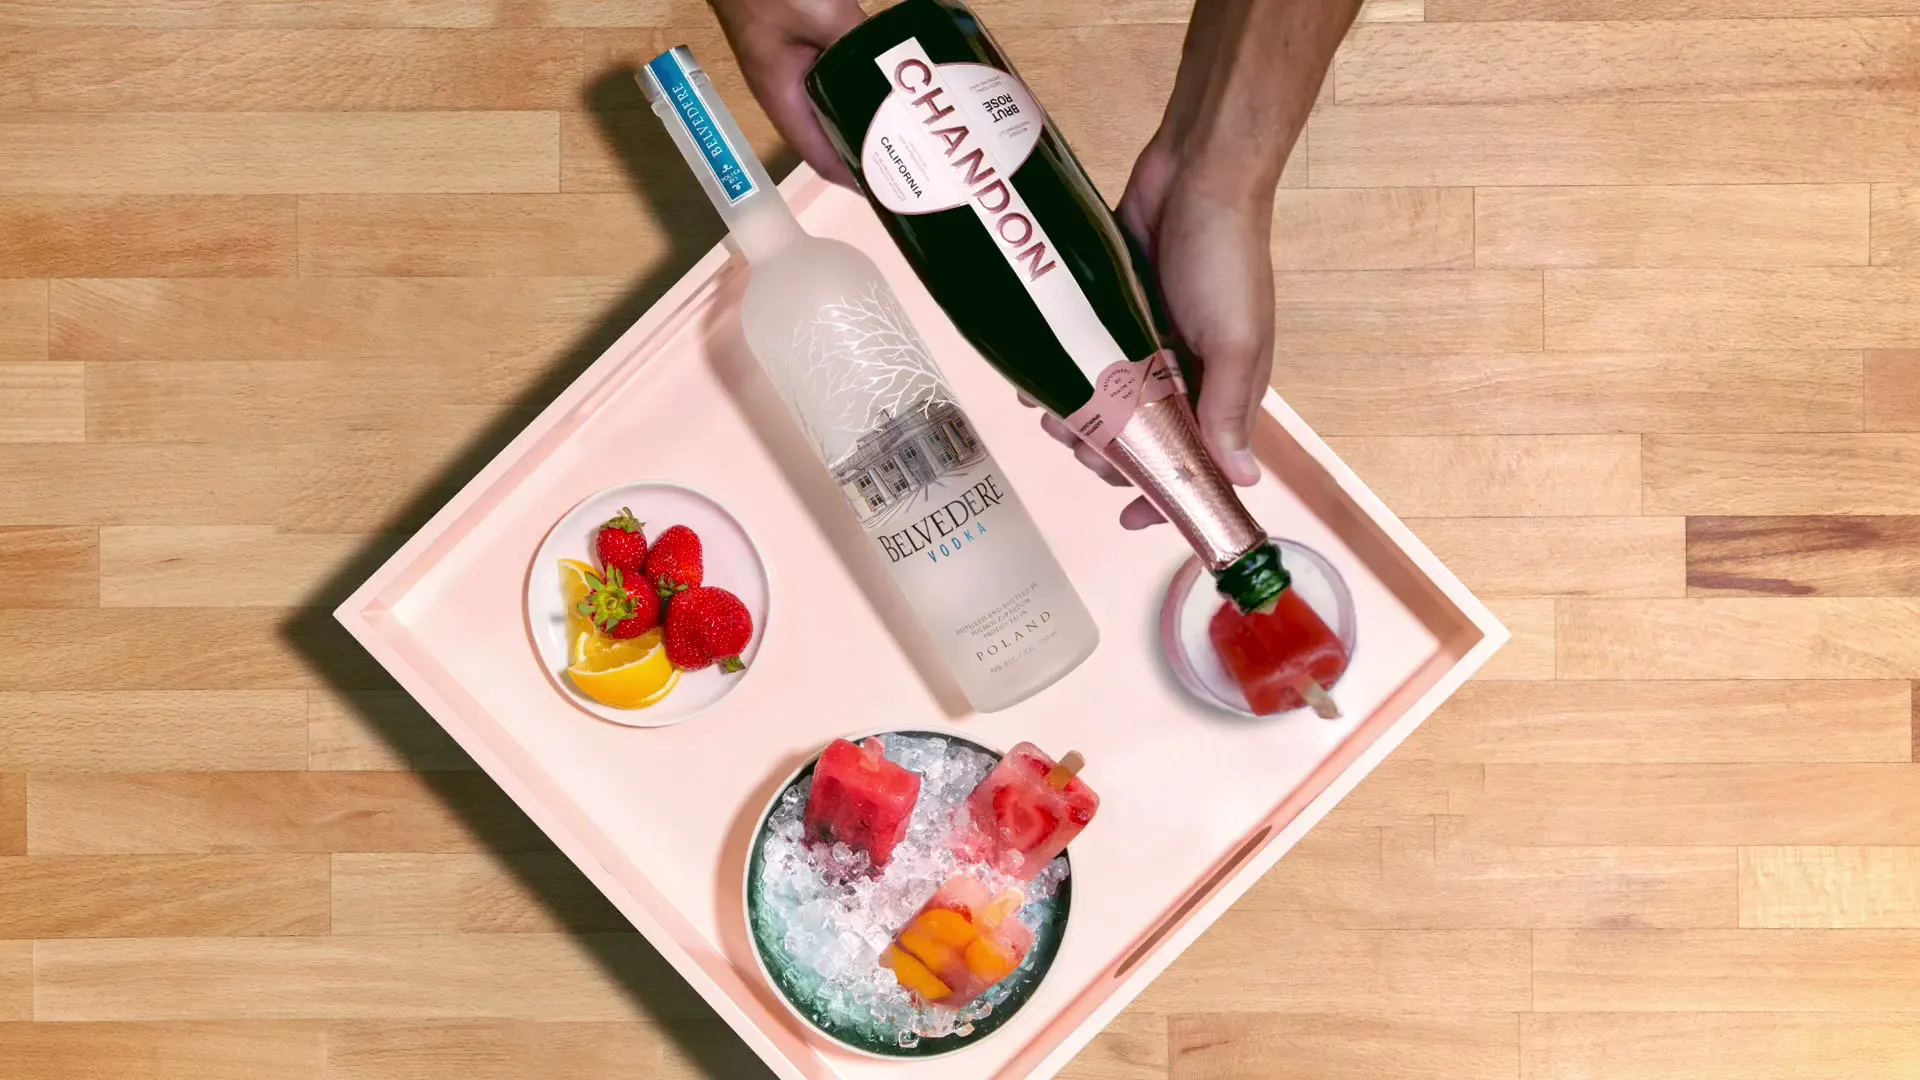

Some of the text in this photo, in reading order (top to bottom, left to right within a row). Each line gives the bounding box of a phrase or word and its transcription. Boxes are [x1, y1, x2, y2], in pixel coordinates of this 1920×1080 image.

[671, 82, 723, 158] BELVEDERE
[989, 103, 1020, 123] BRUT
[878, 135, 924, 198] CALIFORNIA
[895, 58, 1056, 282] CHANDON
[877, 474, 1004, 563] BELVEDERE
[927, 521, 987, 563] VODKA
[975, 611, 1051, 661] POLAND
